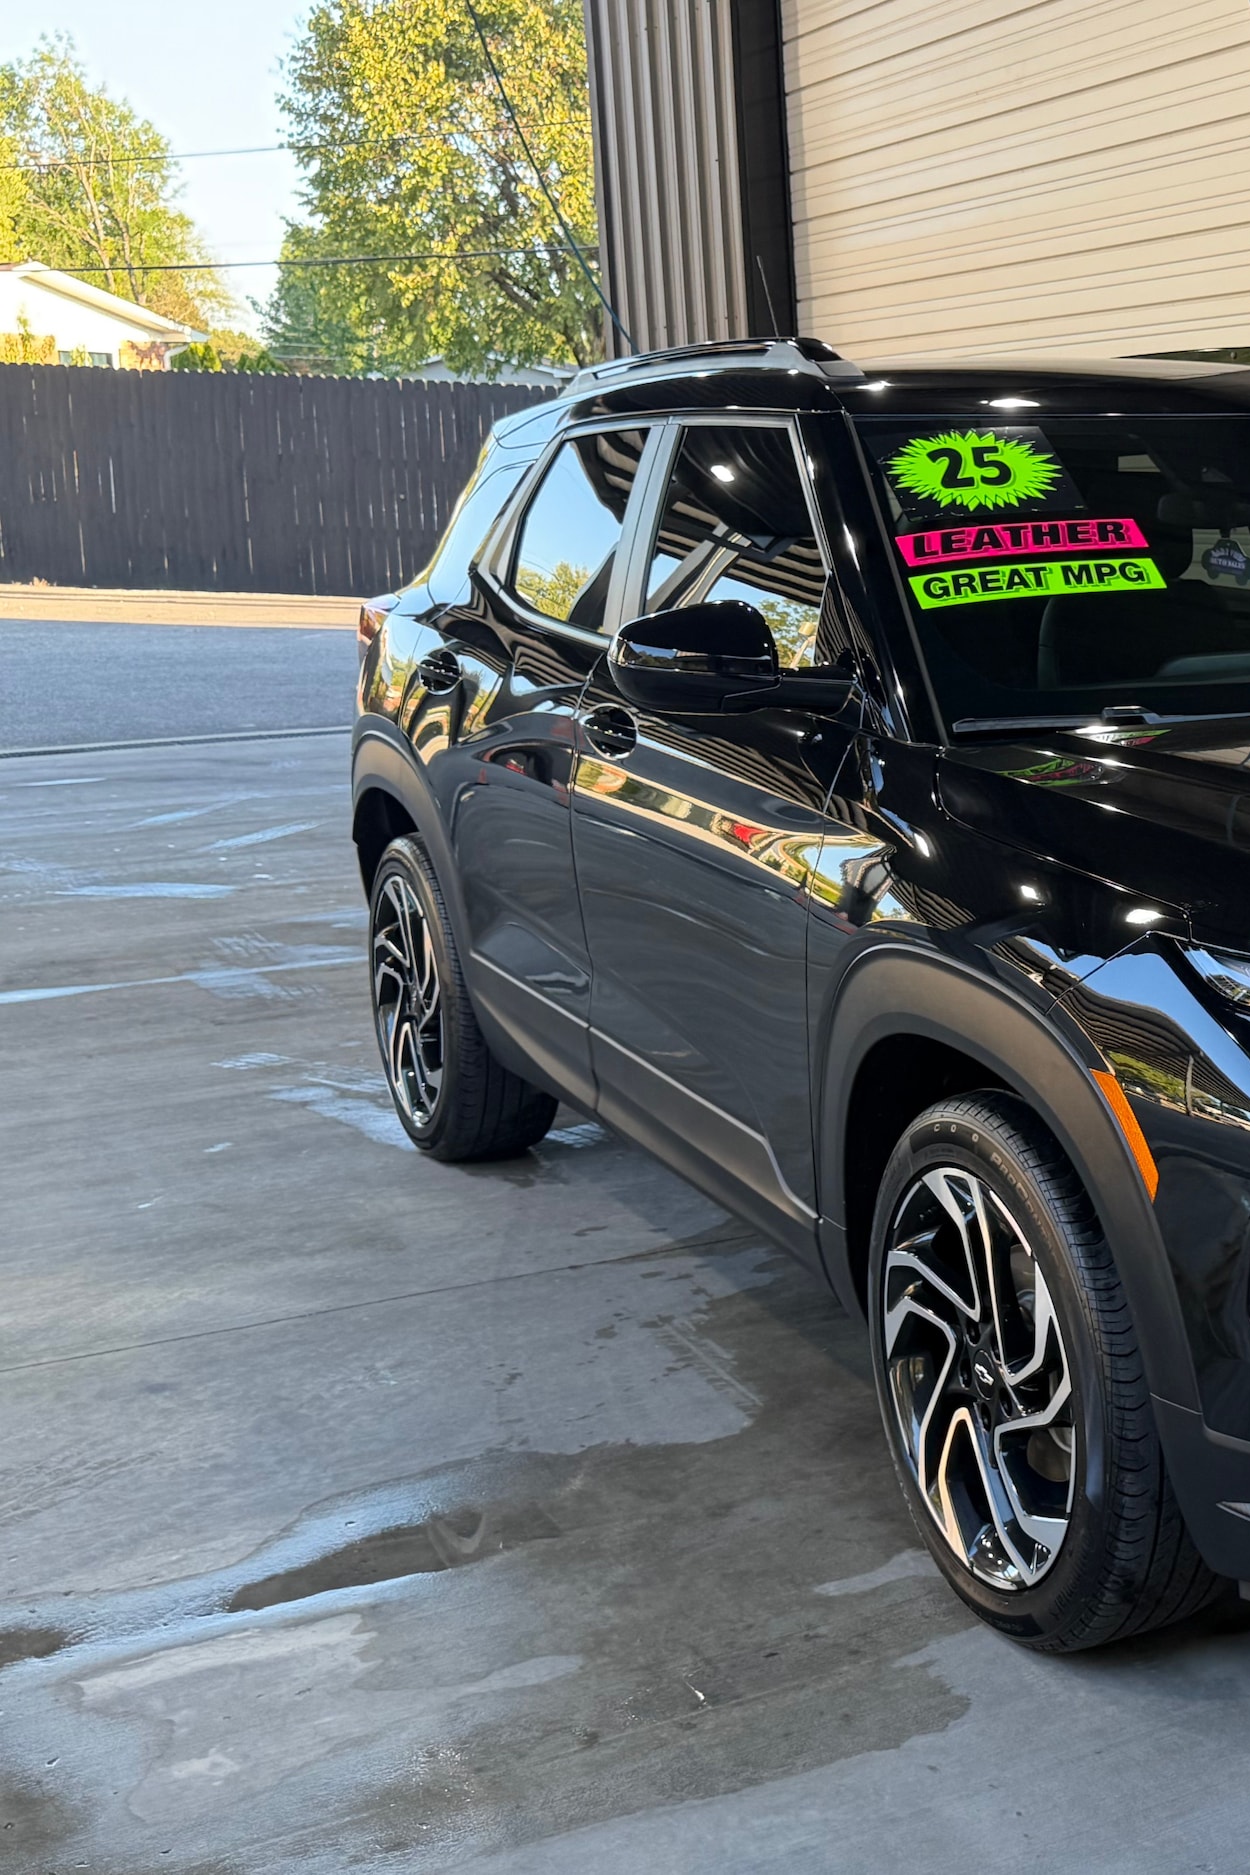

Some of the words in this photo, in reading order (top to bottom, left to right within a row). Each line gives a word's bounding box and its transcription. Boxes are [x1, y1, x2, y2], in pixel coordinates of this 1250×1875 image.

[927, 446, 1012, 490] 25
[913, 521, 1128, 559] LEATHER
[922, 566, 1051, 600] GREAT
[1062, 562, 1147, 588] MPG
